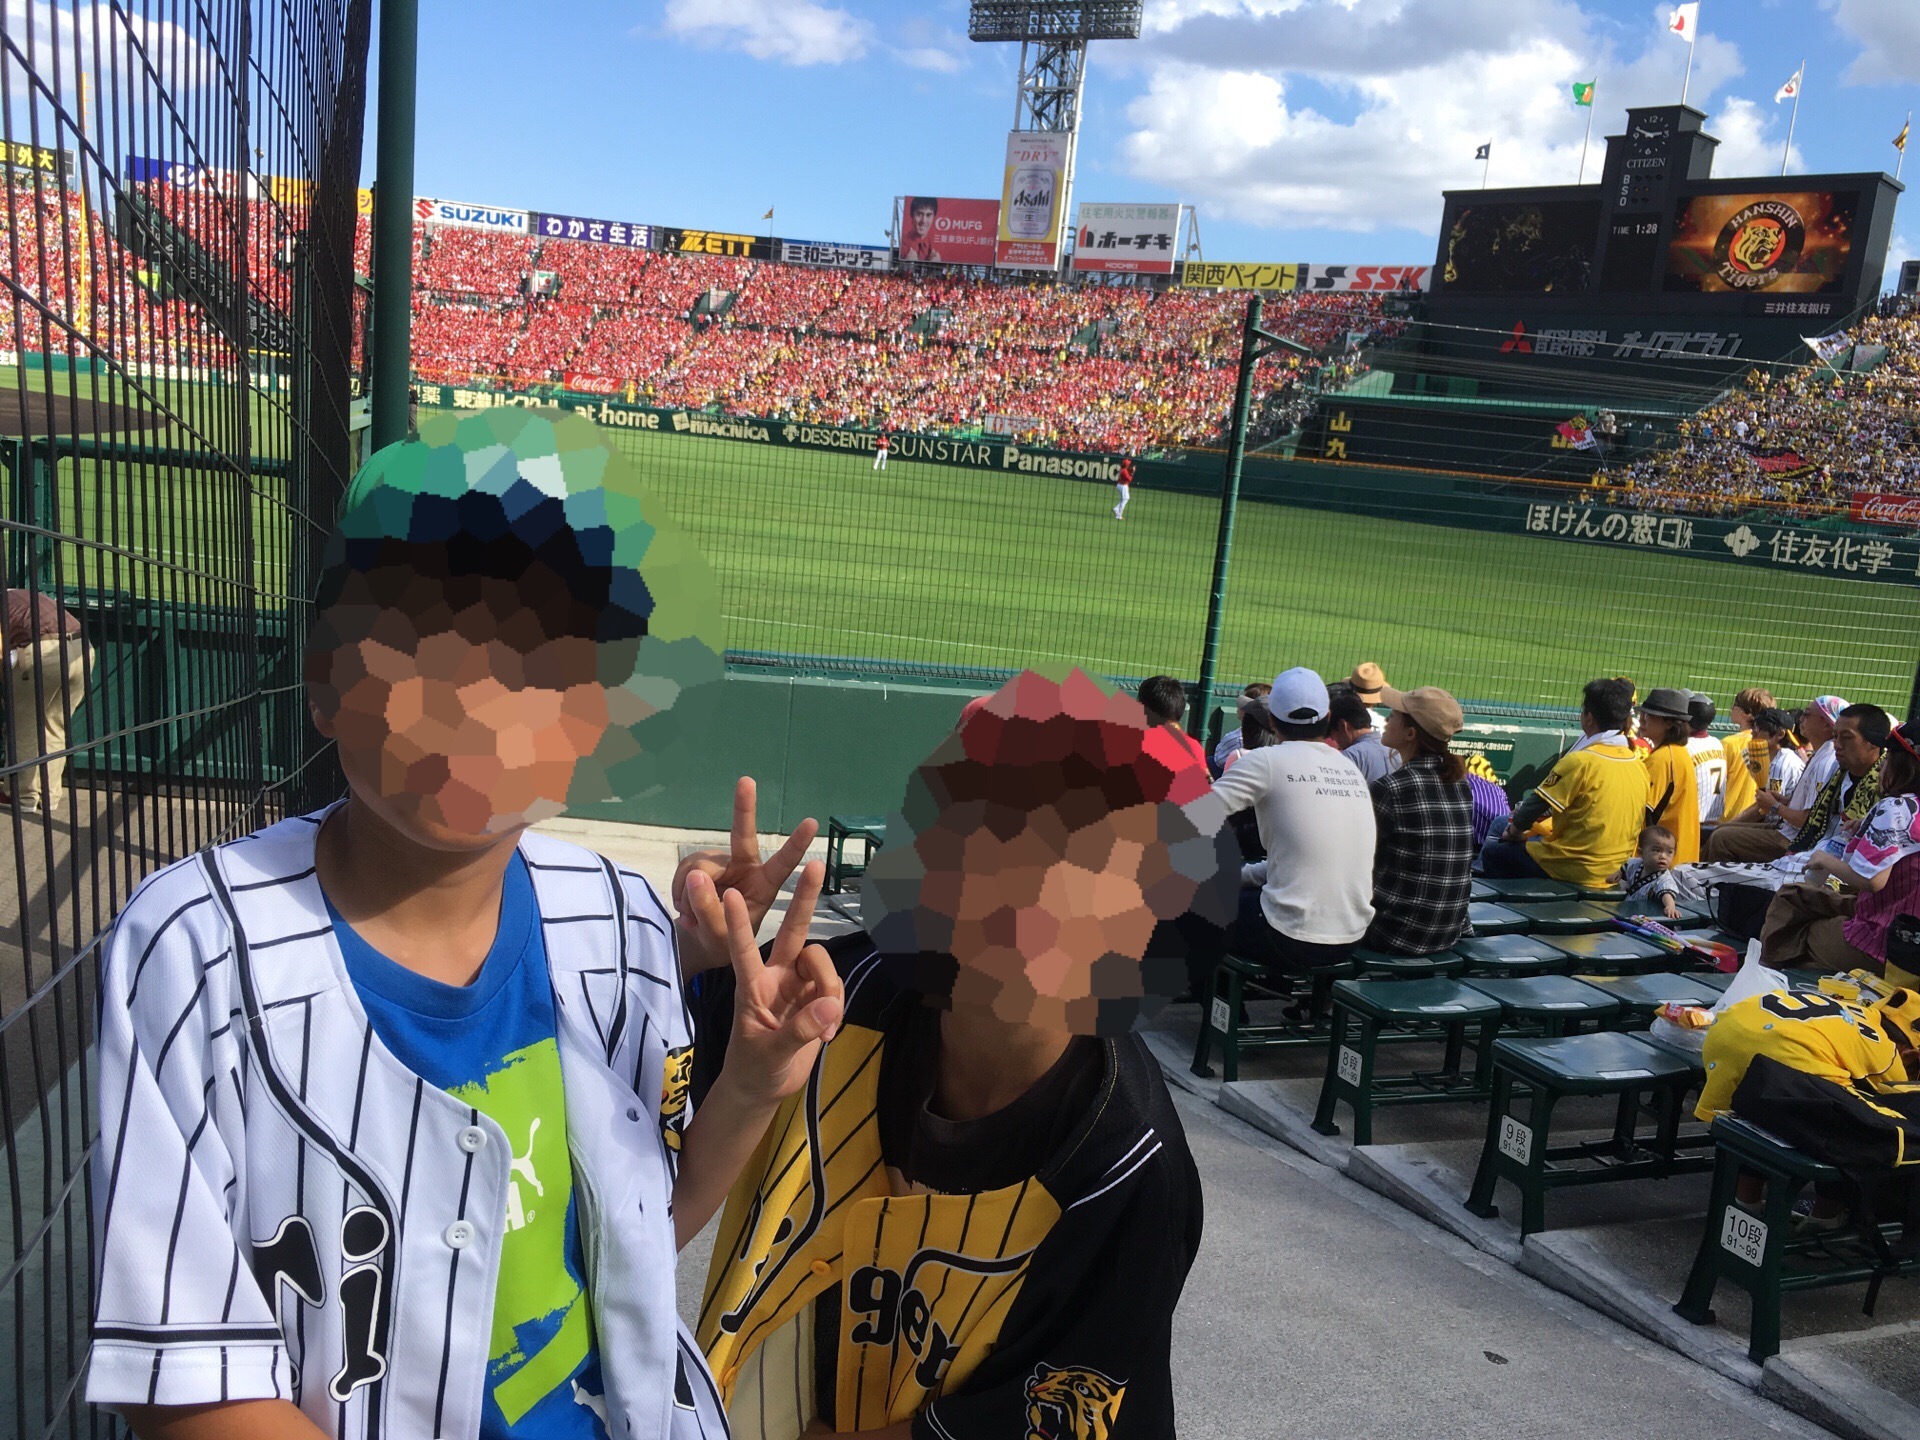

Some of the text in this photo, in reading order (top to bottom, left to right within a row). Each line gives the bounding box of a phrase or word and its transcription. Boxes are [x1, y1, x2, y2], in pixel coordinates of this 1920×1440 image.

[1626, 158, 1666, 168] CITIZEN
[1621, 185, 1628, 195] S
[1623, 174, 1630, 184] B
[1013, 189, 1050, 207] Asahi
[440, 205, 523, 228] SUZUKI
[952, 219, 983, 231] MUFG
[1730, 203, 1798, 228] HANSHIN
[546, 216, 649, 247] わかさ生活
[1097, 231, 1172, 250] ホーチキ
[1613, 223, 1658, 234] TIME 1:28
[679, 230, 756, 257] ZETT
[787, 245, 883, 267] 三和シャッター
[1185, 264, 1295, 288] 関西ペイント
[1350, 266, 1428, 291] SSK
[1718, 261, 1779, 287] Tigers
[1765, 302, 1831, 315] 三井住友銀行
[1537, 329, 1607, 343] MITSUBISHI
[1535, 342, 1596, 356] ELECTRIC
[599, 402, 659, 429] home
[801, 426, 878, 450] DESCENTE
[888, 435, 991, 466] SUNSTAR
[1003, 447, 1121, 482] Panasonic
[1526, 503, 1681, 549] ほけんの窓口
[1769, 529, 1893, 575] 住友化学
[1287, 774, 1320, 783] S.A.R.
[1324, 777, 1360, 786] RESCUE
[1710, 767, 1722, 795] 7
[1316, 788, 1351, 797] AVIREX
[1506, 1123, 1526, 1148] 9段
[1729, 1214, 1763, 1248] 10段
